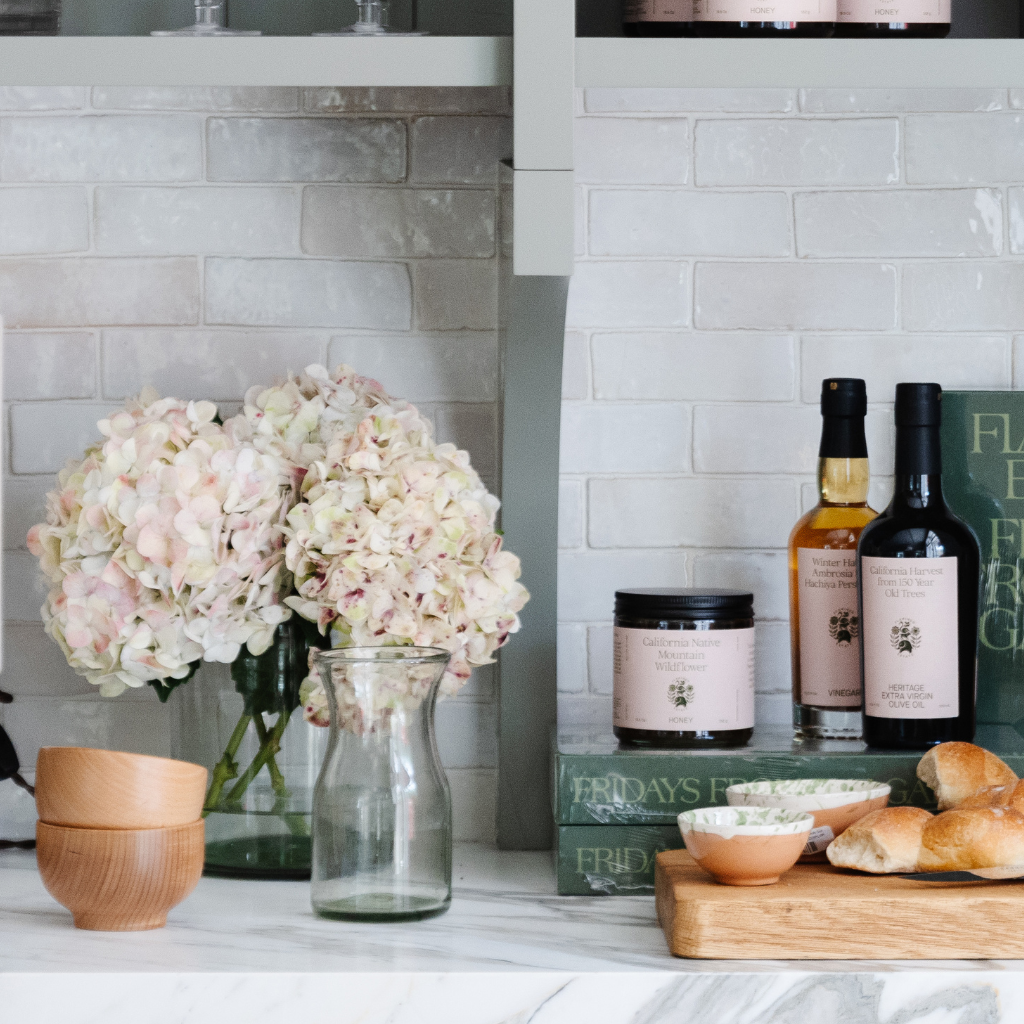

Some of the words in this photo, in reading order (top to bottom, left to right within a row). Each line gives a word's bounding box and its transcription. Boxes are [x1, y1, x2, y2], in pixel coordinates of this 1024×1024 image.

[874, 8, 899, 16] HONEY
[812, 557, 841, 567] Winter
[811, 569, 853, 578] Ambrosia
[869, 565, 908, 576] California
[909, 566, 943, 576] Harvest
[804, 579, 836, 590] Hachiya
[877, 578, 897, 587] from
[899, 578, 913, 587] 150
[914, 578, 935, 587] Year
[885, 589, 899, 598] Old
[901, 589, 926, 598] Trees
[642, 636, 689, 648] California
[691, 638, 720, 648] Native
[658, 650, 705, 660] Mountain
[655, 661, 708, 672] Wildflower
[888, 684, 924, 692] HERITAGE
[828, 689, 861, 697] VINEGAR
[881, 692, 905, 700] EXTRA
[907, 692, 933, 700] VIRGIN
[888, 700, 911, 708] OLIVE
[912, 700, 925, 708] OIL
[572, 776, 700, 805] FRIDAYS
[575, 847, 660, 874] FRID
